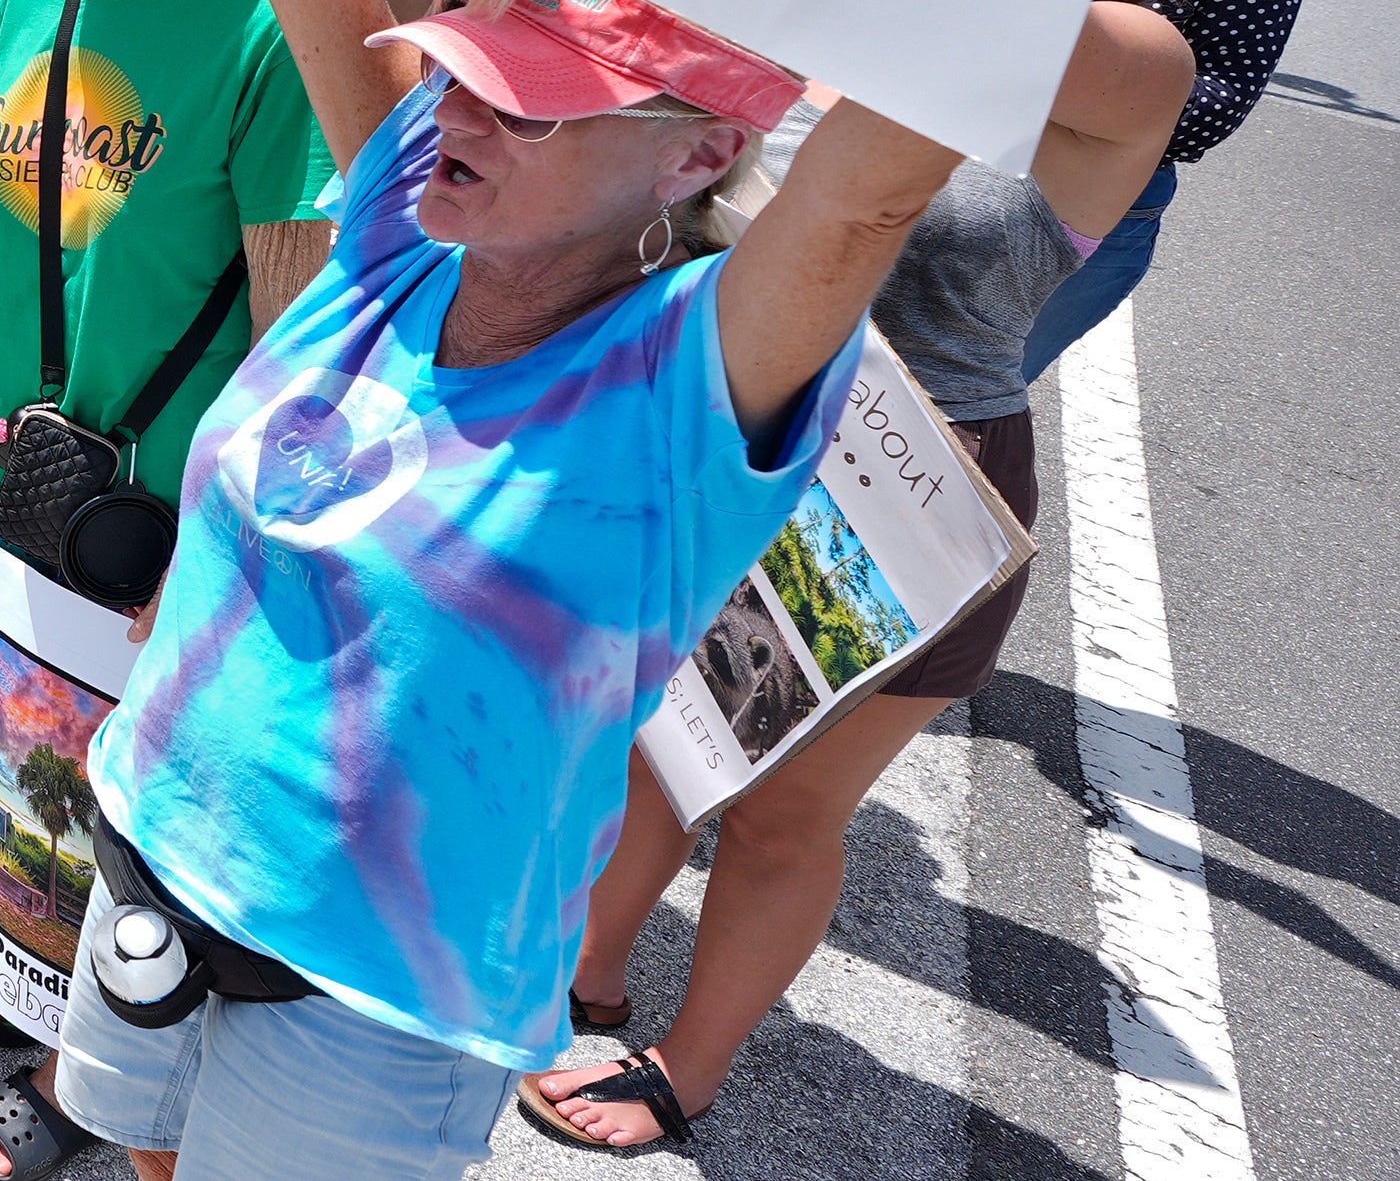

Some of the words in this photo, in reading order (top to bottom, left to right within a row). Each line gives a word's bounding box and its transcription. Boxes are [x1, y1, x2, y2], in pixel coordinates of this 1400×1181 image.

[75, 165, 133, 194] CLUB
[848, 378, 944, 509] about
[678, 697, 724, 771] LET'S
